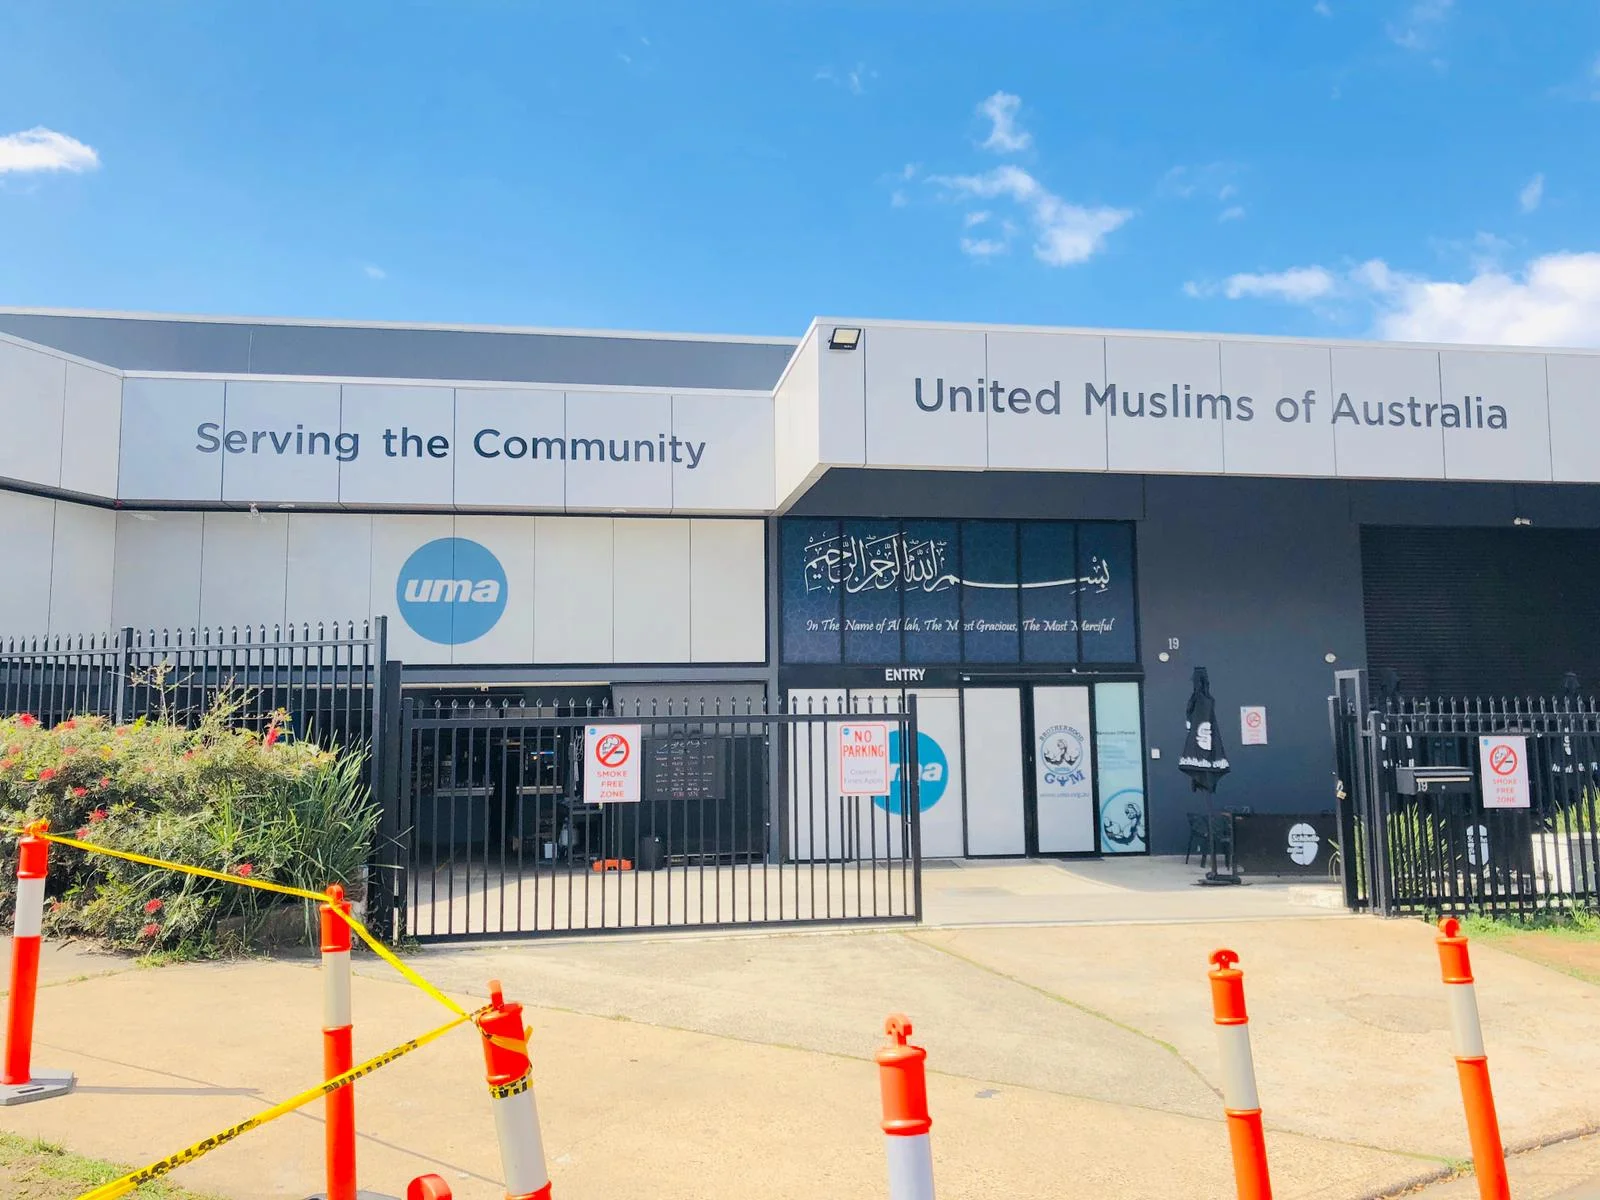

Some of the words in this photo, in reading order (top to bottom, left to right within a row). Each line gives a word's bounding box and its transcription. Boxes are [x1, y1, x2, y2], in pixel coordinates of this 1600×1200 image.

[914, 377, 1061, 415] United
[1085, 382, 1255, 422] Muslims
[1275, 390, 1317, 424] of
[1331, 392, 1508, 430] Australia
[196, 422, 360, 462] Serving
[383, 427, 450, 459] the
[473, 428, 706, 470] Community
[404, 578, 500, 604] uma
[806, 619, 818, 631] In
[822, 617, 840, 631] The
[844, 619, 873, 631] Name
[875, 617, 887, 634] of
[924, 617, 943, 631] The
[976, 619, 1018, 632] Gracious,
[1023, 617, 1041, 631] The
[1044, 619, 1068, 631] Most
[1168, 638, 1180, 650] 19
[885, 669, 926, 682] ENTRY
[854, 730, 872, 742] NO
[843, 745, 885, 758] PARKING
[597, 770, 628, 778] SMOKE
[601, 780, 624, 788] FREE
[1417, 781, 1428, 792] 19
[600, 790, 625, 798] ZONE
[1496, 796, 1517, 804] ZONE
